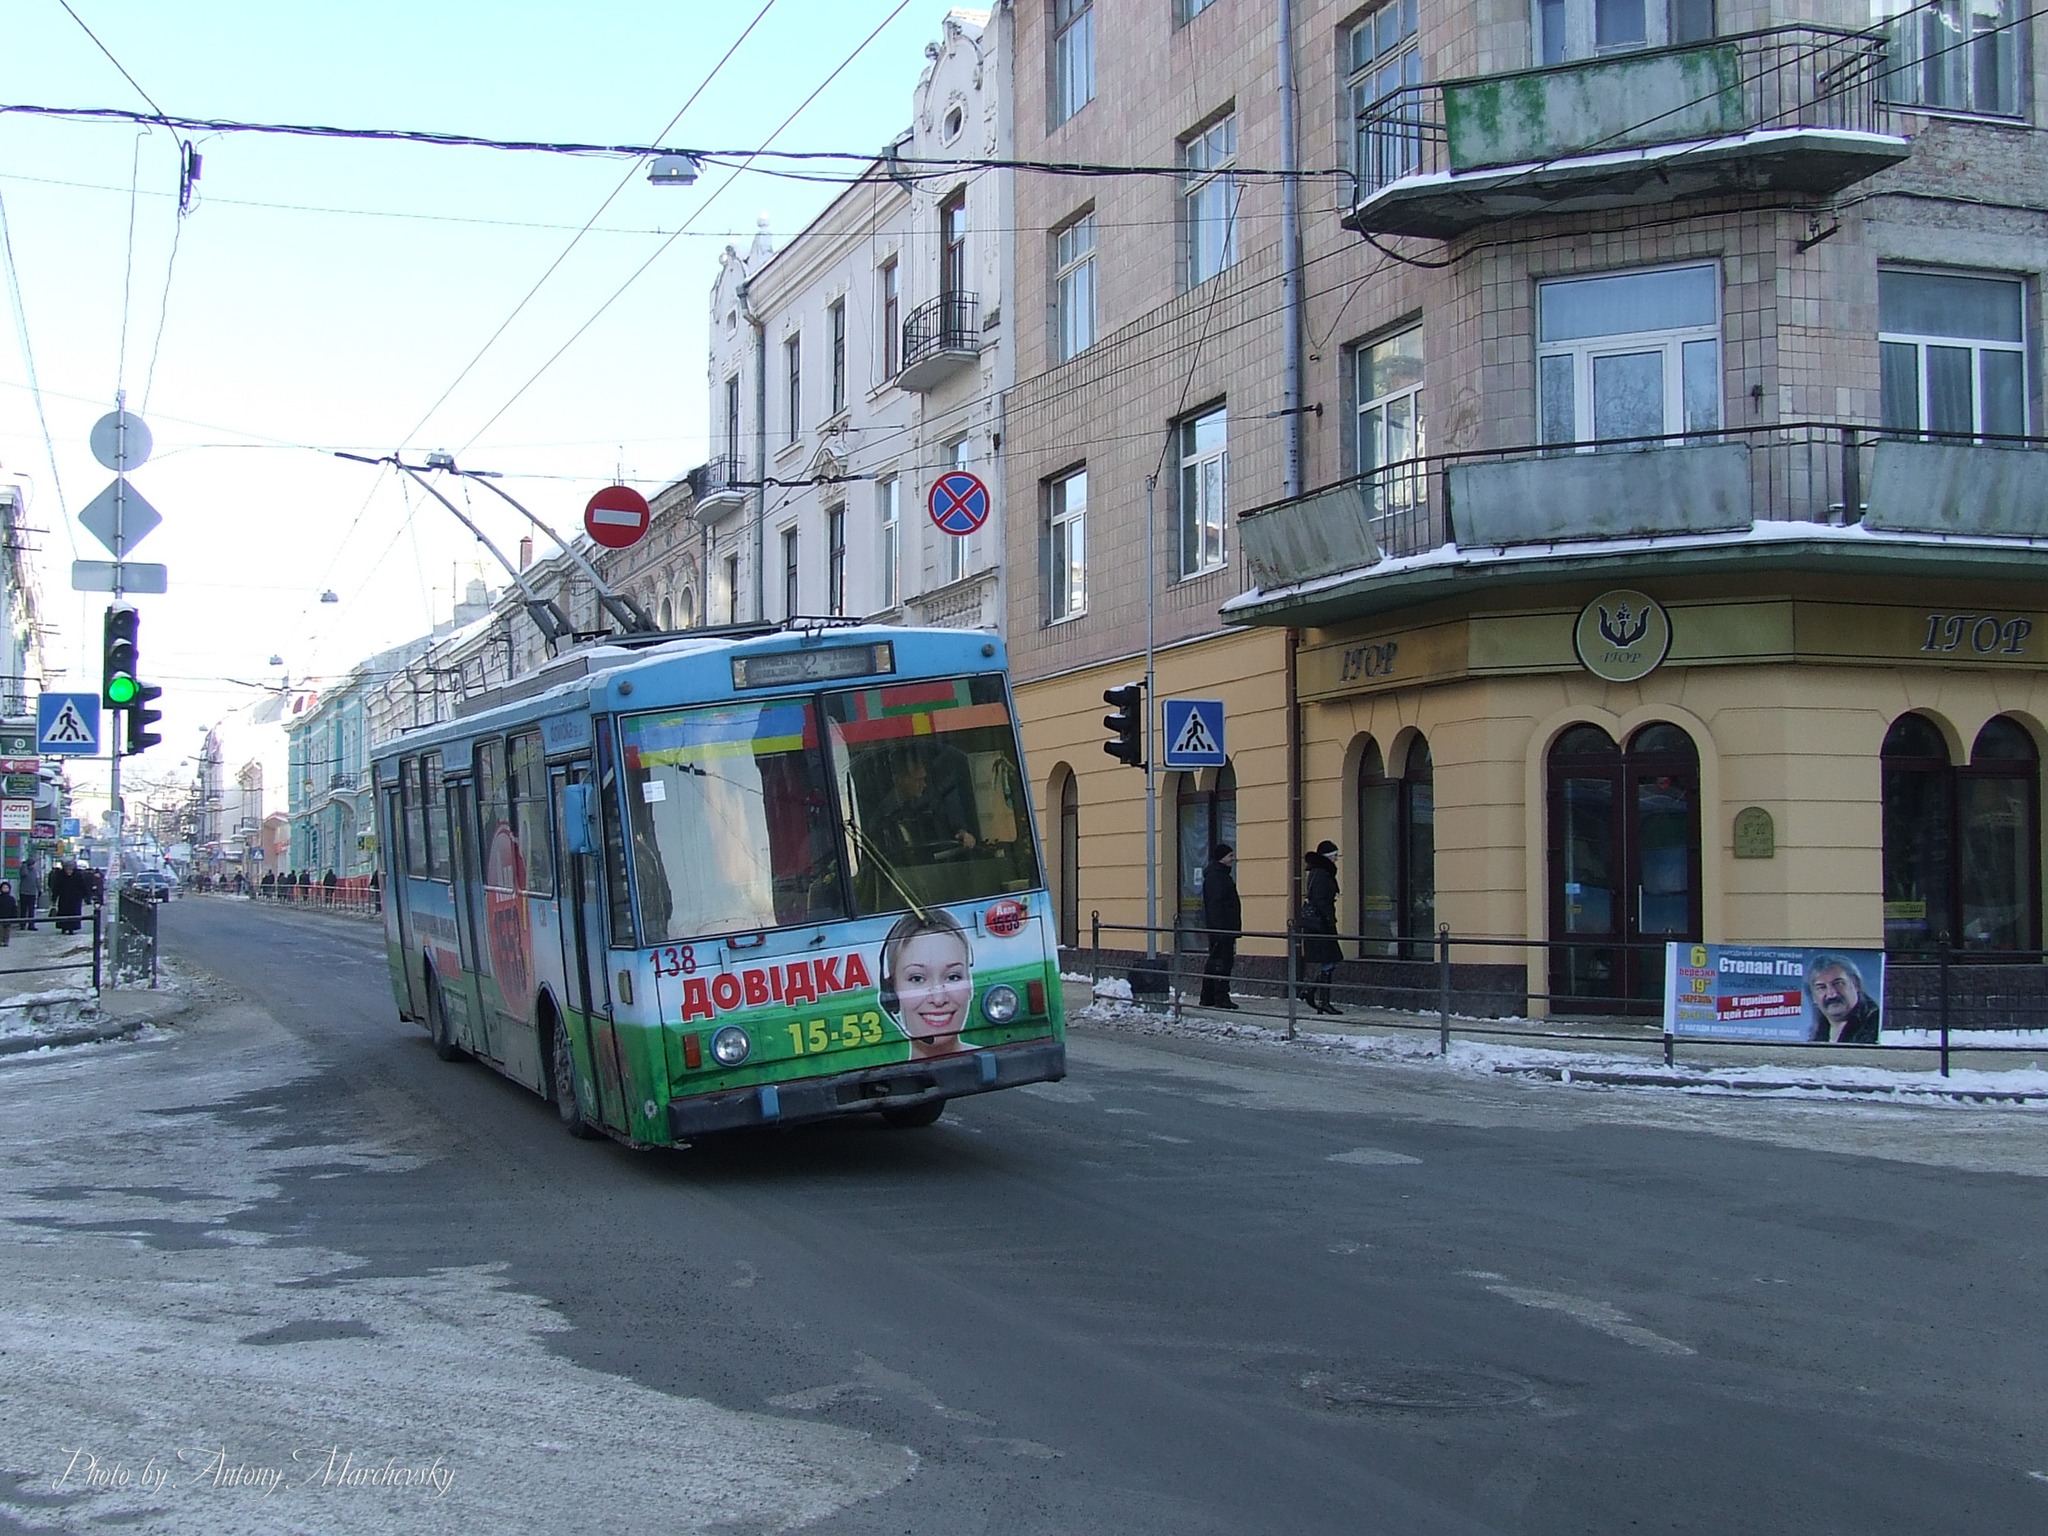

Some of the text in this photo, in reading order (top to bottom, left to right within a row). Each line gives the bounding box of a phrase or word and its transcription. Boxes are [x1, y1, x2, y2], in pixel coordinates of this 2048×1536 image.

[650, 944, 697, 979] 138
[1690, 945, 1708, 968] 6
[1719, 957, 1773, 975] Степан
[680, 951, 873, 1023] ДОВІДКА
[1740, 995, 1784, 1006] прийшов
[1723, 1009, 1741, 1020] цей
[1743, 1007, 1762, 1018] світ
[1764, 1005, 1802, 1016] любити
[788, 1010, 884, 1055] 15-53
